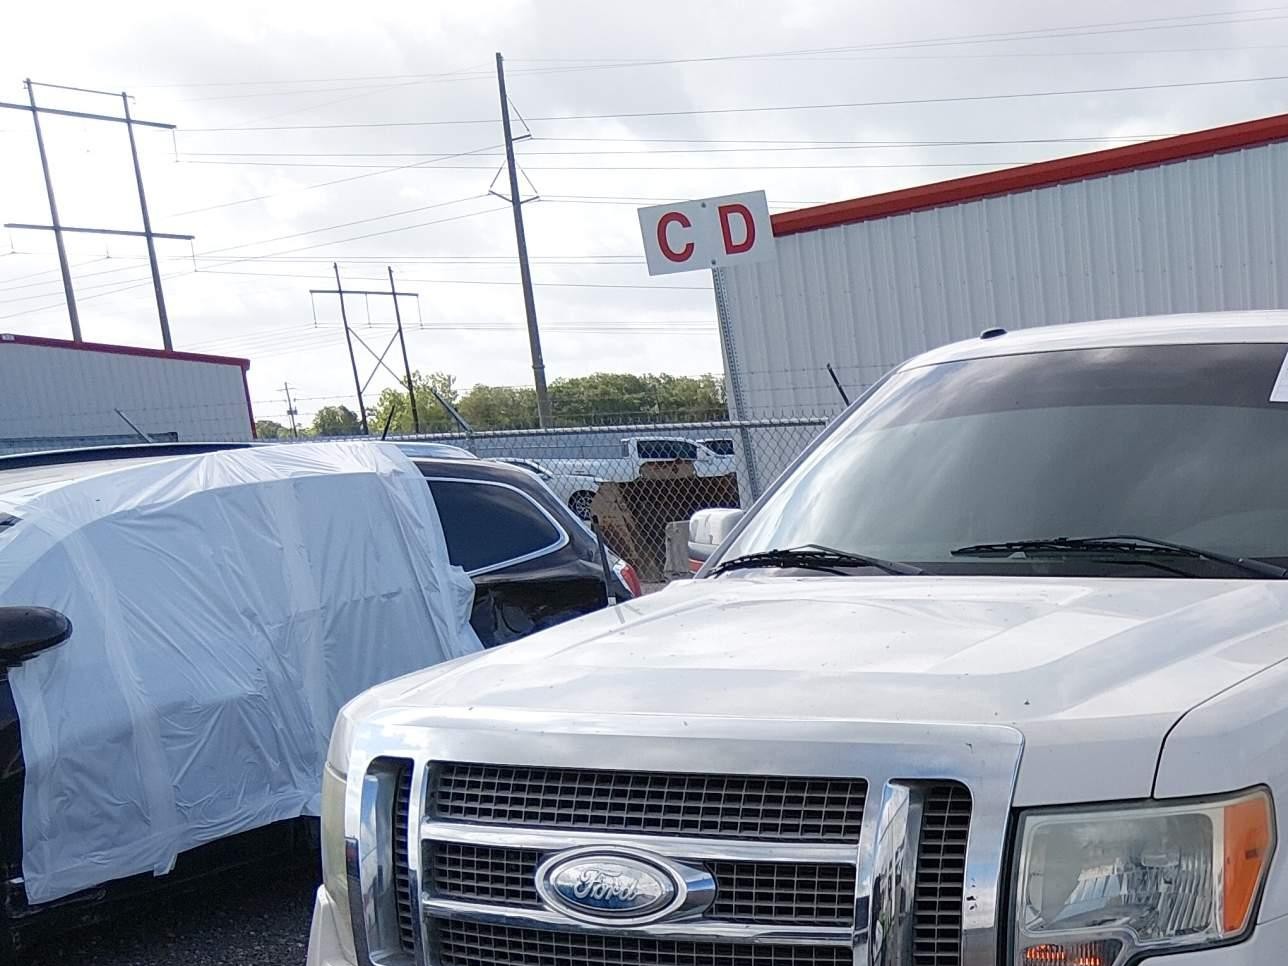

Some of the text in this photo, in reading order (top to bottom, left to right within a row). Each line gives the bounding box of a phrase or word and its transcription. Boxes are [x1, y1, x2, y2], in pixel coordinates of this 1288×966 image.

[657, 203, 756, 263] C D
[573, 869, 641, 901] Ford
